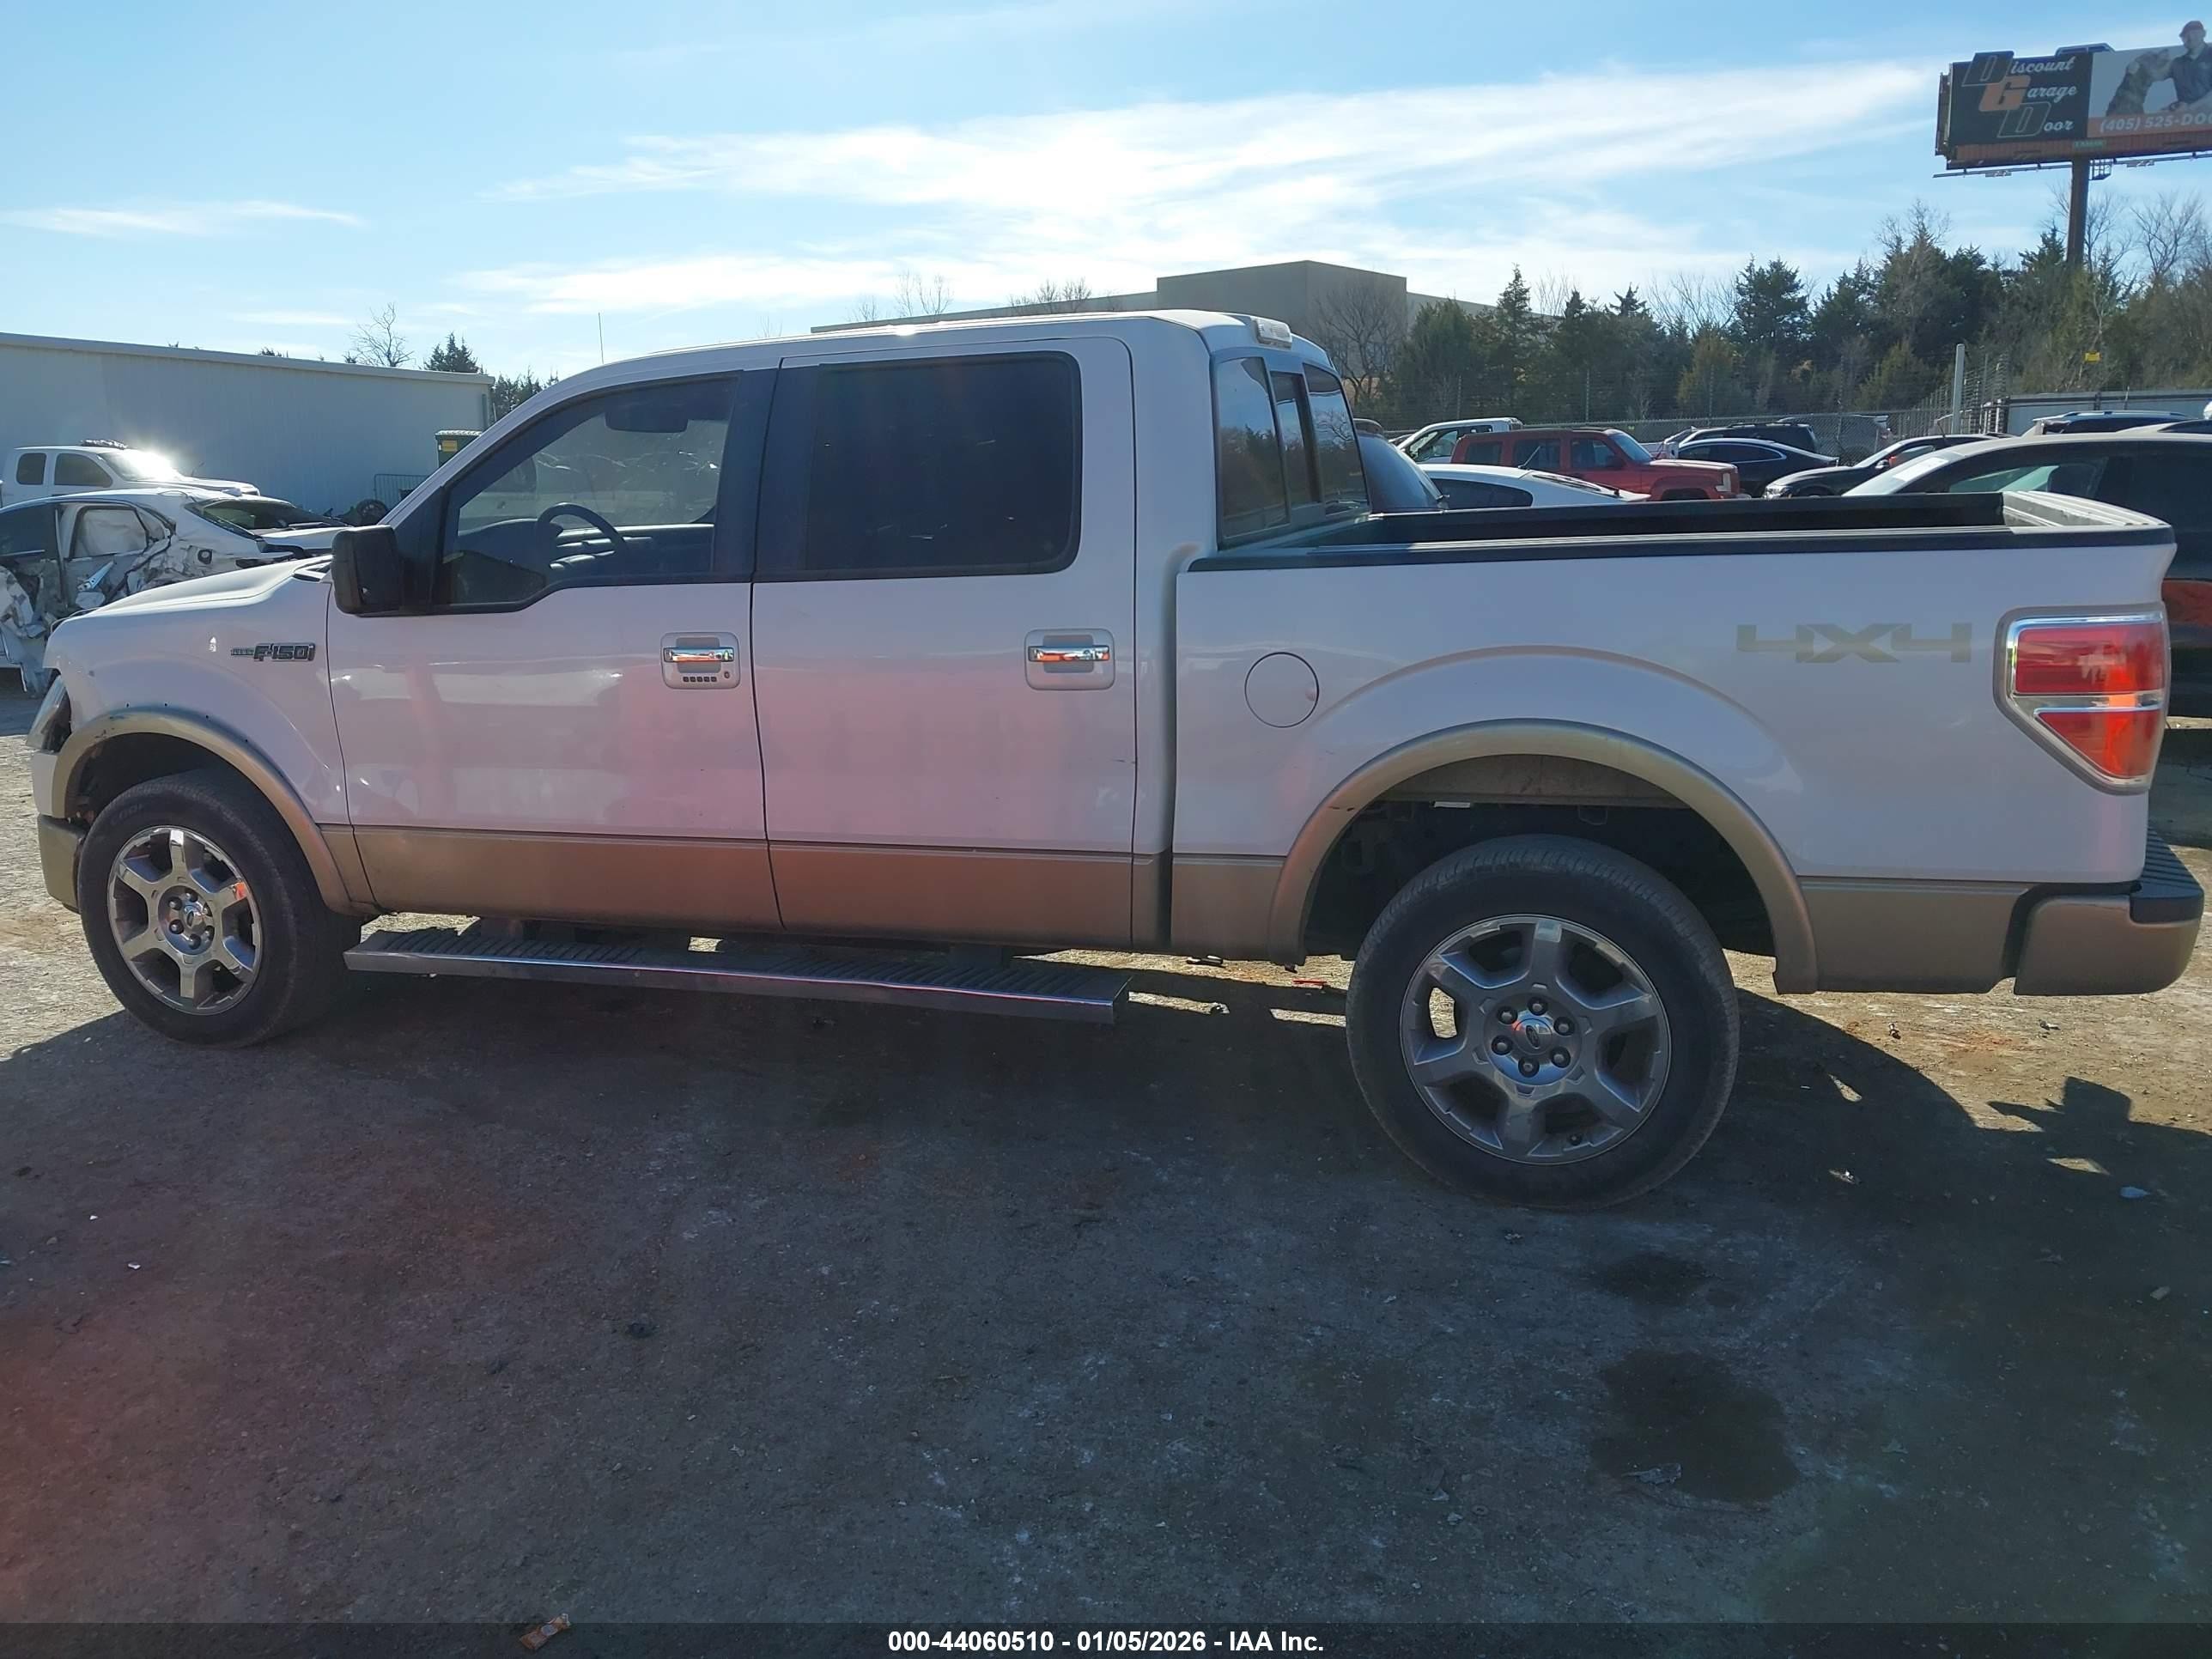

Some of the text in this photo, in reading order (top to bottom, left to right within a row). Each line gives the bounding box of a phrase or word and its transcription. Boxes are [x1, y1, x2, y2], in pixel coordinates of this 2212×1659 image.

[1961, 51, 2076, 87] Discount
[1978, 75, 2077, 112] Garage
[1996, 101, 2074, 137] Door
[2100, 117, 2142, 134] (405)
[253, 643, 315, 662] F-150
[1736, 623, 1972, 663] 4X4
